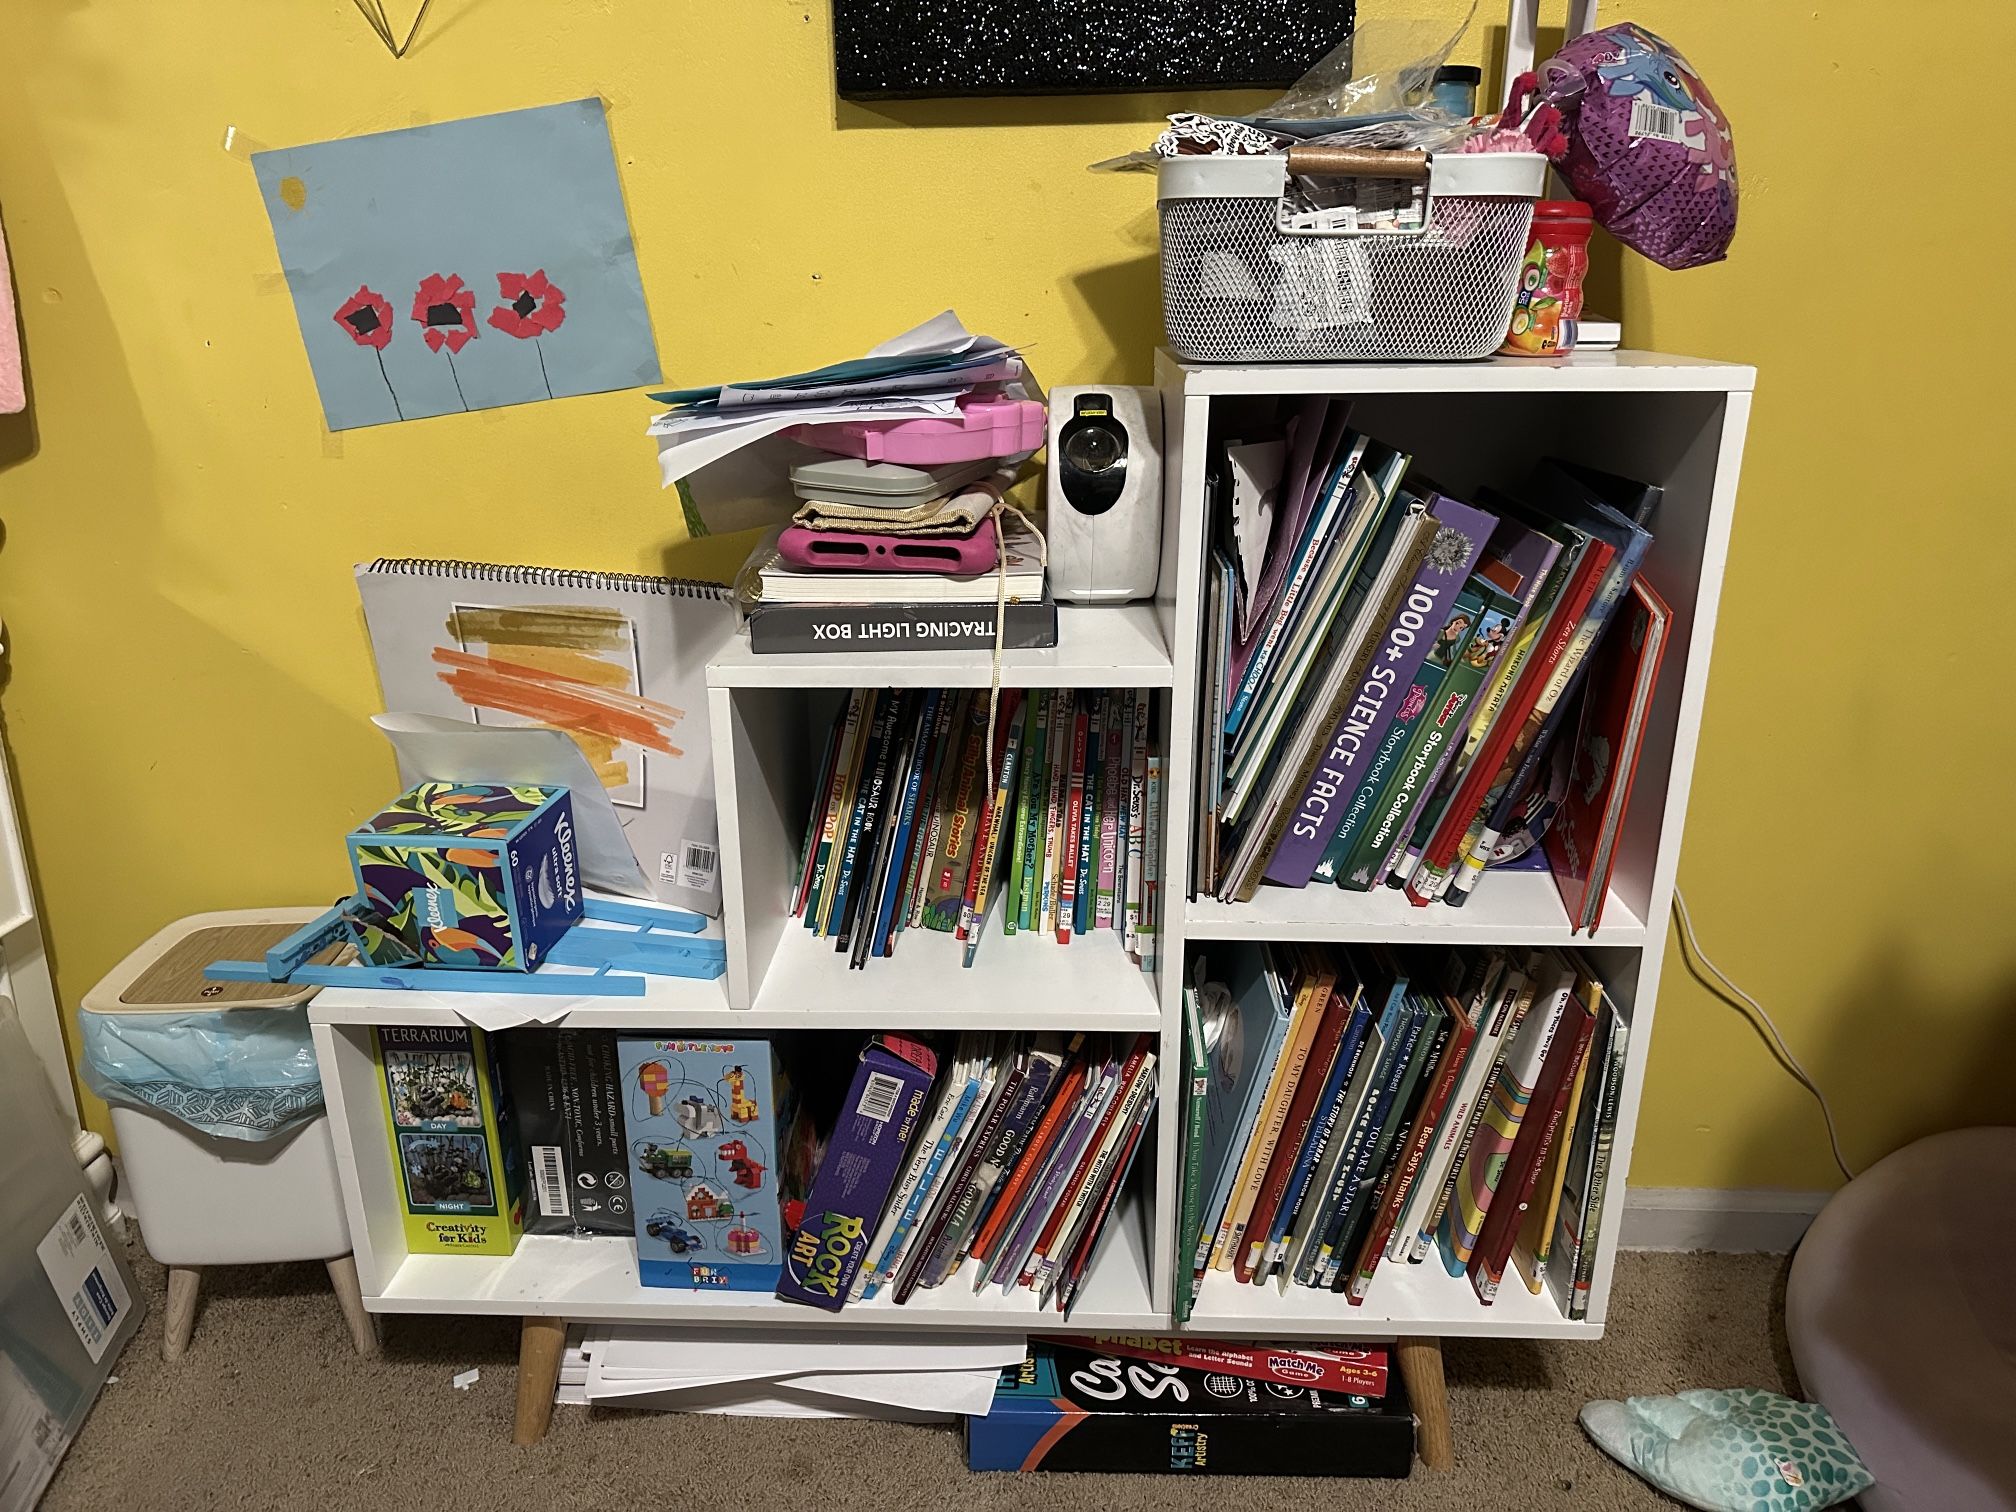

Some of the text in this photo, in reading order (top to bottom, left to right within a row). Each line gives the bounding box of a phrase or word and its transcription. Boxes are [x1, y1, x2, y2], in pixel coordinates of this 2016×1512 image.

[1300, 538, 1319, 572] Because
[1284, 582, 1299, 607] Little
[1274, 608, 1288, 625] Bug
[813, 620, 996, 640] TRACING LIGHT BOX
[1265, 628, 1278, 647] went
[1548, 620, 1576, 664] Zen Shorts
[1578, 628, 1594, 645] The
[1504, 649, 1525, 680] HAKUNA
[1559, 647, 1583, 678] Wizard
[1487, 681, 1507, 712] MATATA
[925, 705, 934, 720] THE
[1292, 582, 1438, 840] 1000+ SCIENCE FACTS
[917, 722, 930, 757] AMAZING
[912, 760, 922, 780] BOOK
[1001, 753, 1012, 783] CLANTON
[1031, 771, 1041, 790] Are
[1105, 756, 1120, 794] Phoebe
[860, 779, 870, 794] THE
[1338, 725, 1405, 839] Storybook Collection
[1370, 730, 1442, 849] Storybook Collection
[822, 774, 846, 839] HOP POP
[856, 798, 866, 814] CAT
[945, 734, 982, 857] Silly Animal Stories
[1030, 792, 1039, 809] You
[1084, 794, 1092, 811] CAT
[902, 792, 915, 825] SHARKS
[1102, 811, 1116, 830] Her
[849, 828, 858, 842] THE
[511, 850, 518, 866] 60
[845, 846, 856, 864] HAT
[985, 841, 994, 864] UNICORN
[1024, 829, 1036, 868] Mother?
[1081, 844, 1089, 862] HAT
[1098, 831, 1116, 873] Unicorn
[552, 847, 560, 876] ultra
[554, 812, 575, 912] Kleenex
[1021, 876, 1032, 911] Eastman
[1041, 881, 1049, 911] PERKINS
[425, 881, 438, 933] Kleenex
[1314, 987, 1327, 1013] GREEN
[382, 1029, 468, 1042] TERRARIUM
[1390, 1017, 1408, 1050] THOMPSON
[1418, 1030, 1434, 1061] CANNON
[1346, 1049, 1360, 1077] BRUNHOFF
[1379, 1057, 1391, 1078] SAVAGE
[1388, 1024, 1421, 1092] Parker Rossell
[1004, 1080, 1017, 1096] THE
[1100, 1055, 1138, 1126] AMELIA WHO COULD FLY
[1335, 1089, 1346, 1103] THE
[906, 1089, 923, 1117] made
[936, 1093, 954, 1121] Eric Carle
[958, 1094, 971, 1111] Mike
[990, 1098, 1008, 1124] POLAR
[1015, 1085, 1038, 1119] Rathmann
[1269, 1080, 1295, 1135] DAUGHTER,
[1326, 1104, 1339, 1127] STORY
[1443, 1102, 1467, 1149] WILD ANIMALS
[896, 1124, 910, 1142] me!
[973, 1125, 993, 1157] EXPRESS
[995, 1128, 1015, 1156] GOOD
[1301, 1115, 1327, 1168] STELLALUNA
[1365, 1125, 1381, 1148] YOU
[920, 1139, 934, 1155] The
[1259, 1139, 1274, 1164] WITH
[1312, 1138, 1326, 1162] BABAR
[909, 1155, 925, 1172] Very
[1355, 1150, 1370, 1172] ARE
[1391, 1126, 1433, 1208] Bear Says Thanks
[1595, 1155, 1605, 1168] The
[899, 1172, 917, 1192] Busy
[902, 1148, 944, 1220] ELLIE
[1250, 1166, 1264, 1190] LOVE
[1300, 1173, 1312, 1196] RANDOM
[1590, 1171, 1603, 1194] Other
[888, 1190, 908, 1216] Spider
[940, 1165, 972, 1220] CHRIS VAN ALLSBURG
[950, 1183, 977, 1226] GORILLA
[1338, 1185, 1357, 1216] STAR!
[1588, 1195, 1599, 1212] Side
[1292, 1198, 1302, 1214] HOUSE
[426, 1222, 487, 1235] Creativity
[439, 1232, 487, 1243] for Kids
[792, 1230, 820, 1268] ART
[801, 1210, 864, 1298] ROCK
[694, 1266, 717, 1276] FUN
[839, 1241, 863, 1286] CREATE YOUR OWN
[1187, 1345, 1253, 1362] Learn the Alphabet
[1203, 1354, 1224, 1363] Letter
[1226, 1358, 1253, 1367] Sounds
[1268, 1357, 1324, 1376] Match Me
[1282, 1369, 1309, 1378] Game
[1340, 1366, 1377, 1377] Ages 3-6
[1353, 1376, 1375, 1387] Players
[1171, 1431, 1195, 1469] KEFF
[1195, 1433, 1208, 1466] Artistry
